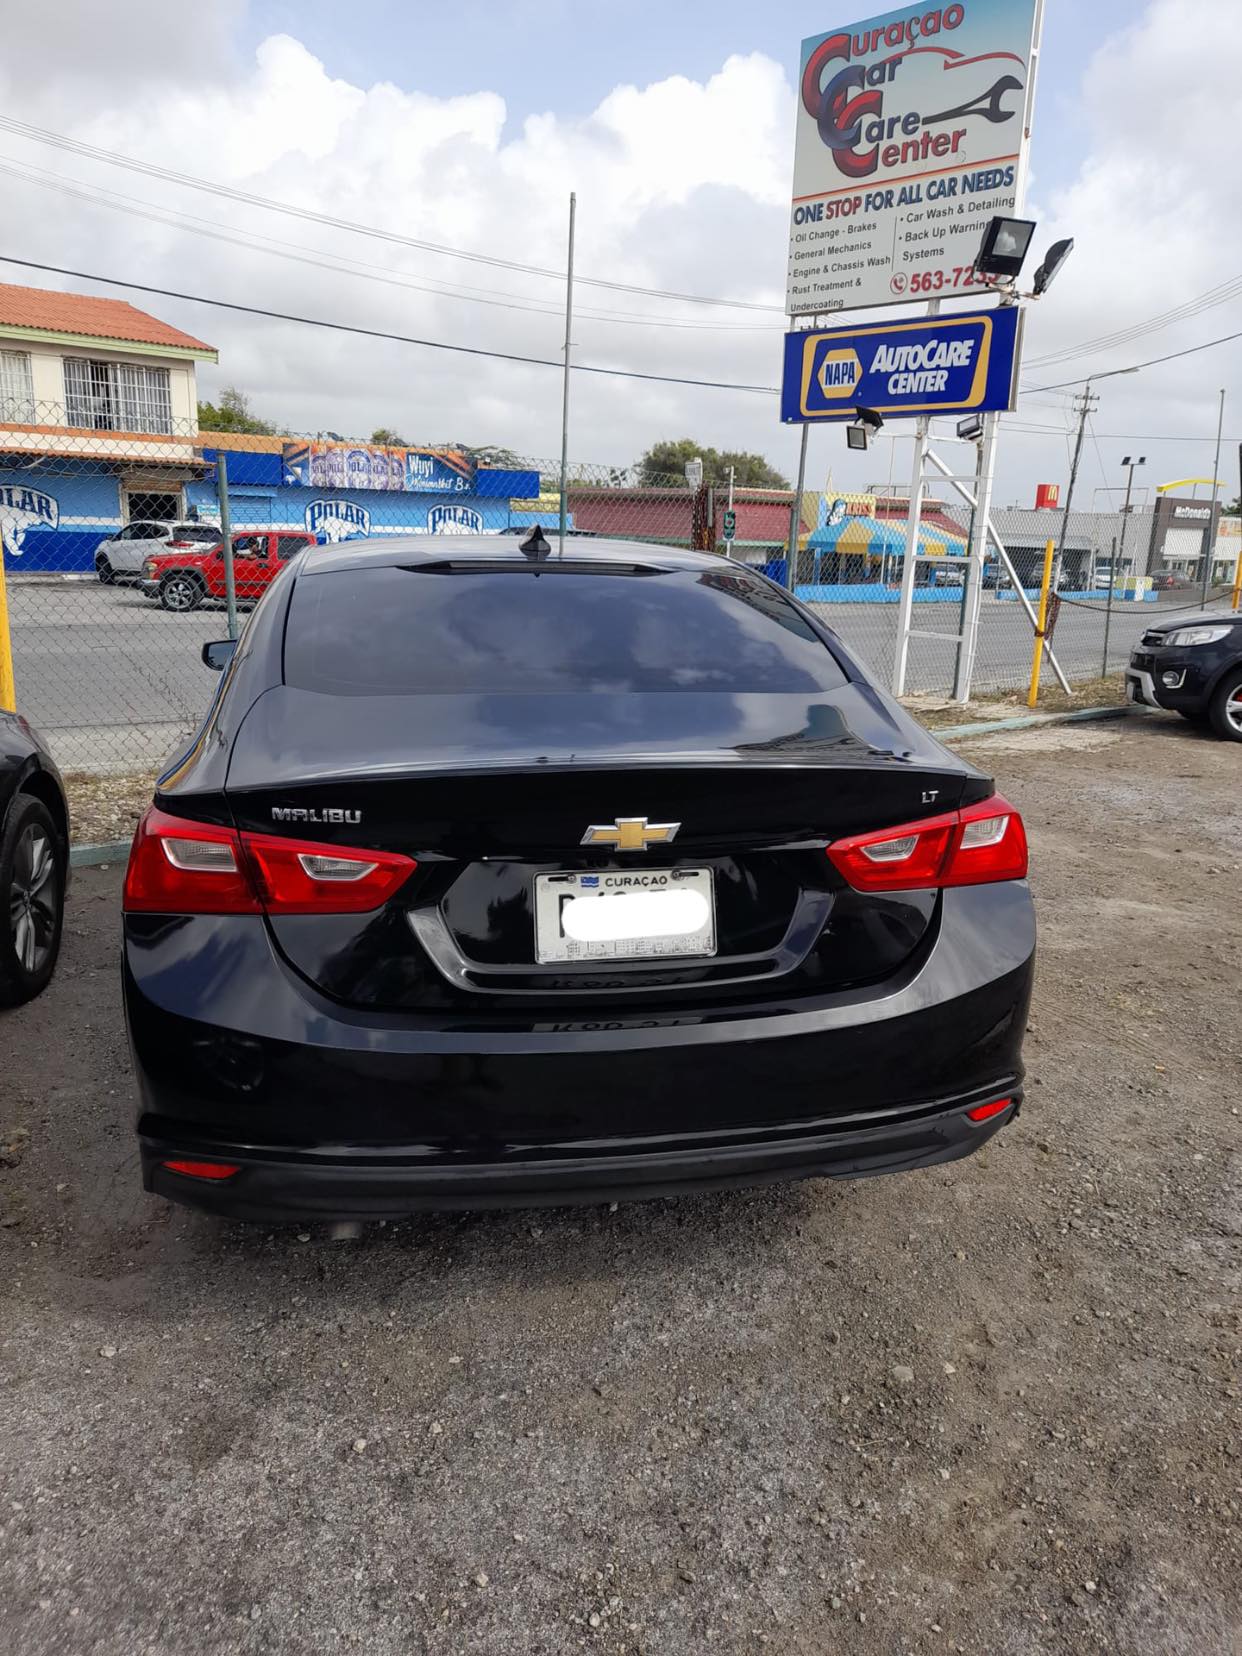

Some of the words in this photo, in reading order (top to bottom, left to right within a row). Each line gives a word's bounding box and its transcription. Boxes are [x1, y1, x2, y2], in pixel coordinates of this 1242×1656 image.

[802, 3, 965, 121] Curaçao
[817, 56, 903, 149] Car
[793, 202, 824, 226] ONE
[825, 195, 862, 220] STOP
[864, 188, 895, 213] FOR
[896, 183, 923, 206] ALL
[926, 177, 958, 200] CAR
[961, 165, 1015, 195] NEEDS
[906, 211, 924, 223] Car
[926, 205, 954, 220] Wash
[956, 203, 965, 214] &
[968, 196, 1015, 210] Detailing
[795, 230, 807, 243] Oil
[808, 226, 840, 240] Change
[847, 221, 877, 234] Brakes
[904, 230, 929, 243] Back
[932, 226, 946, 239] Up
[949, 219, 990, 235] Warnin
[794, 248, 825, 261] General
[827, 241, 872, 256] Mechanics
[902, 246, 945, 262] Systems
[793, 267, 821, 279] Engine
[823, 264, 829, 274] &
[831, 260, 864, 273] Chassis
[867, 255, 891, 267] Wash
[792, 283, 811, 295] Rust
[813, 277, 854, 291] Treatment
[855, 276, 862, 287] &
[790, 298, 844, 313] Undercoating
[824, 360, 855, 387] NAPA
[887, 369, 949, 396] CENTER
[408, 455, 434, 478] Wuyi
[0, 488, 53, 521] LAR
[309, 502, 366, 531] POLAR
[431, 506, 479, 534] POLAR
[921, 790, 939, 804] LT
[271, 807, 362, 824] MALIBU
[605, 875, 668, 888] CURAÇAO
